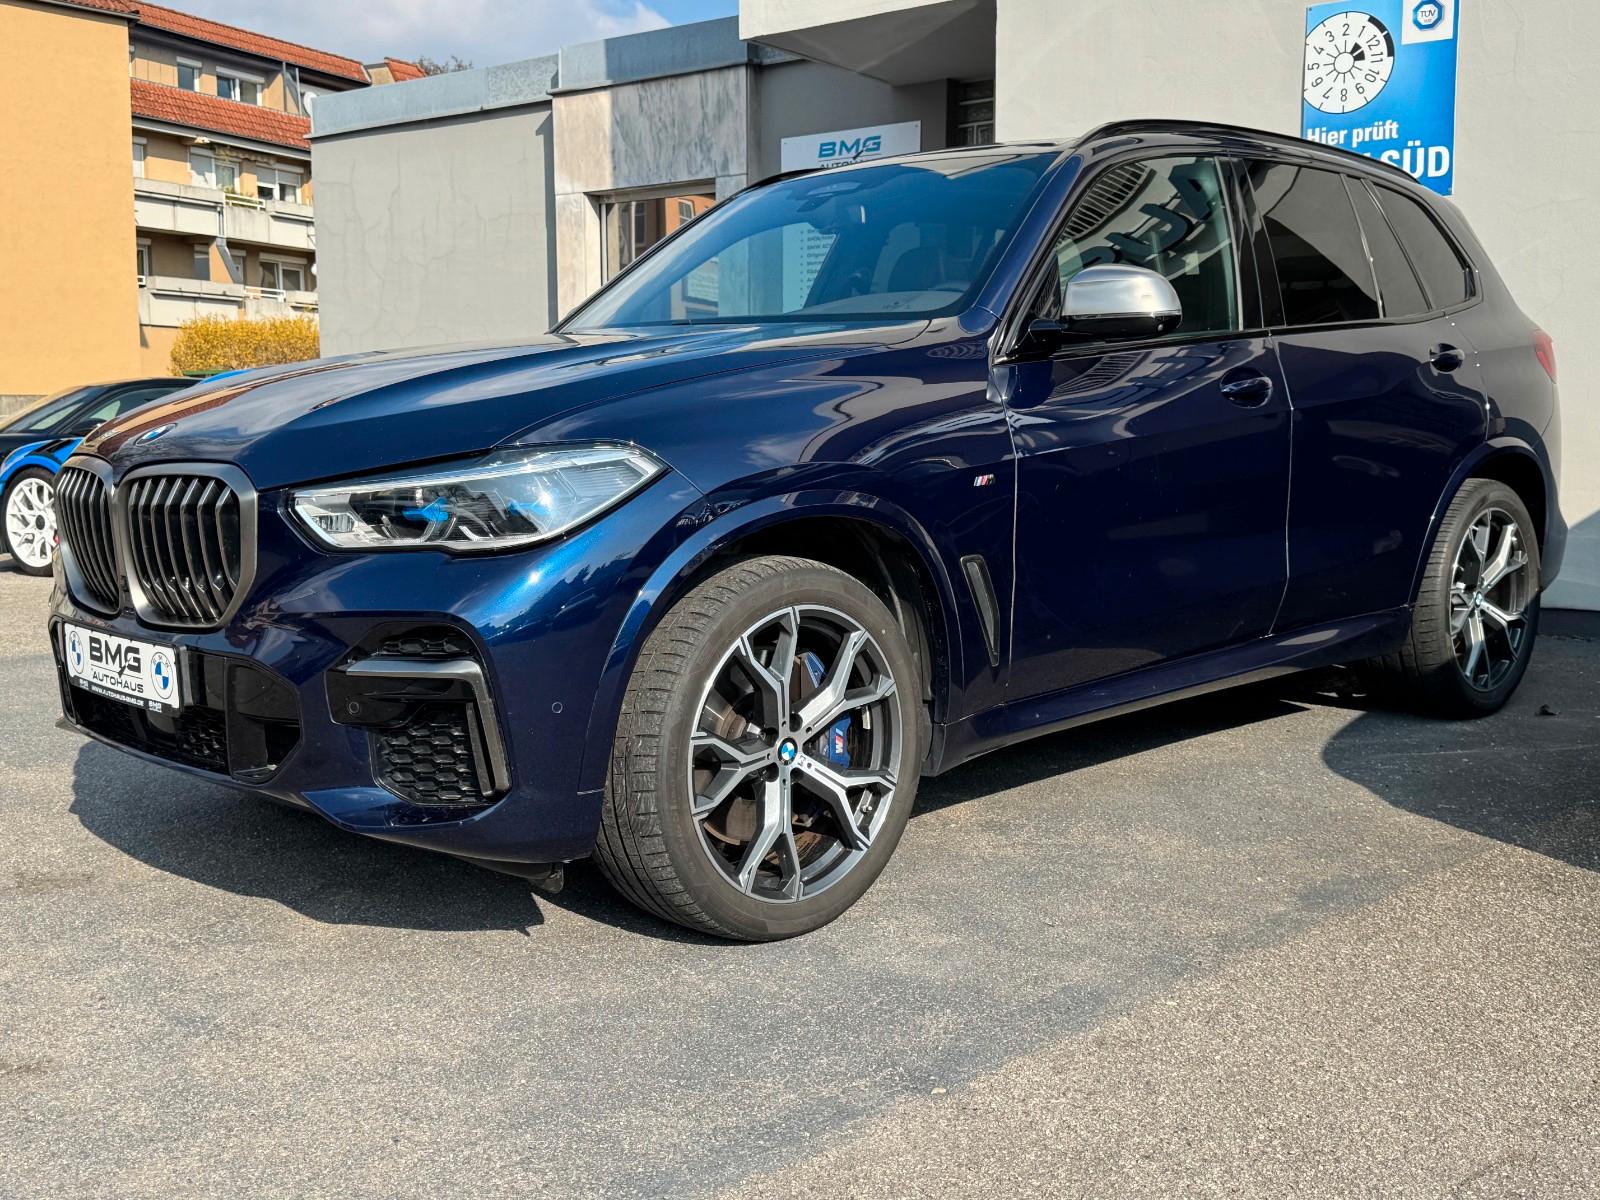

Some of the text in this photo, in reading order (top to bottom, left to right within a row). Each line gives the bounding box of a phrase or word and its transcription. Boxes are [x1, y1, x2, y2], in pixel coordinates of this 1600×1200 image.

[1342, 23, 1350, 36] 2
[1358, 25, 1366, 38] 1
[1325, 30, 1335, 43] 3
[1366, 34, 1381, 51] 12
[1313, 45, 1324, 55] 4
[1371, 51, 1384, 63] 11
[1307, 62, 1320, 71] 5
[1311, 76, 1323, 88] 6
[1364, 68, 1380, 83] 10
[1322, 86, 1333, 100] 7
[1340, 88, 1348, 102] 8
[1354, 82, 1365, 95] 9
[1307, 119, 1399, 148] Hier prüft
[818, 135, 881, 159] BMG
[89, 636, 141, 674] BMG
[92, 671, 144, 693] AUTOHAUS
